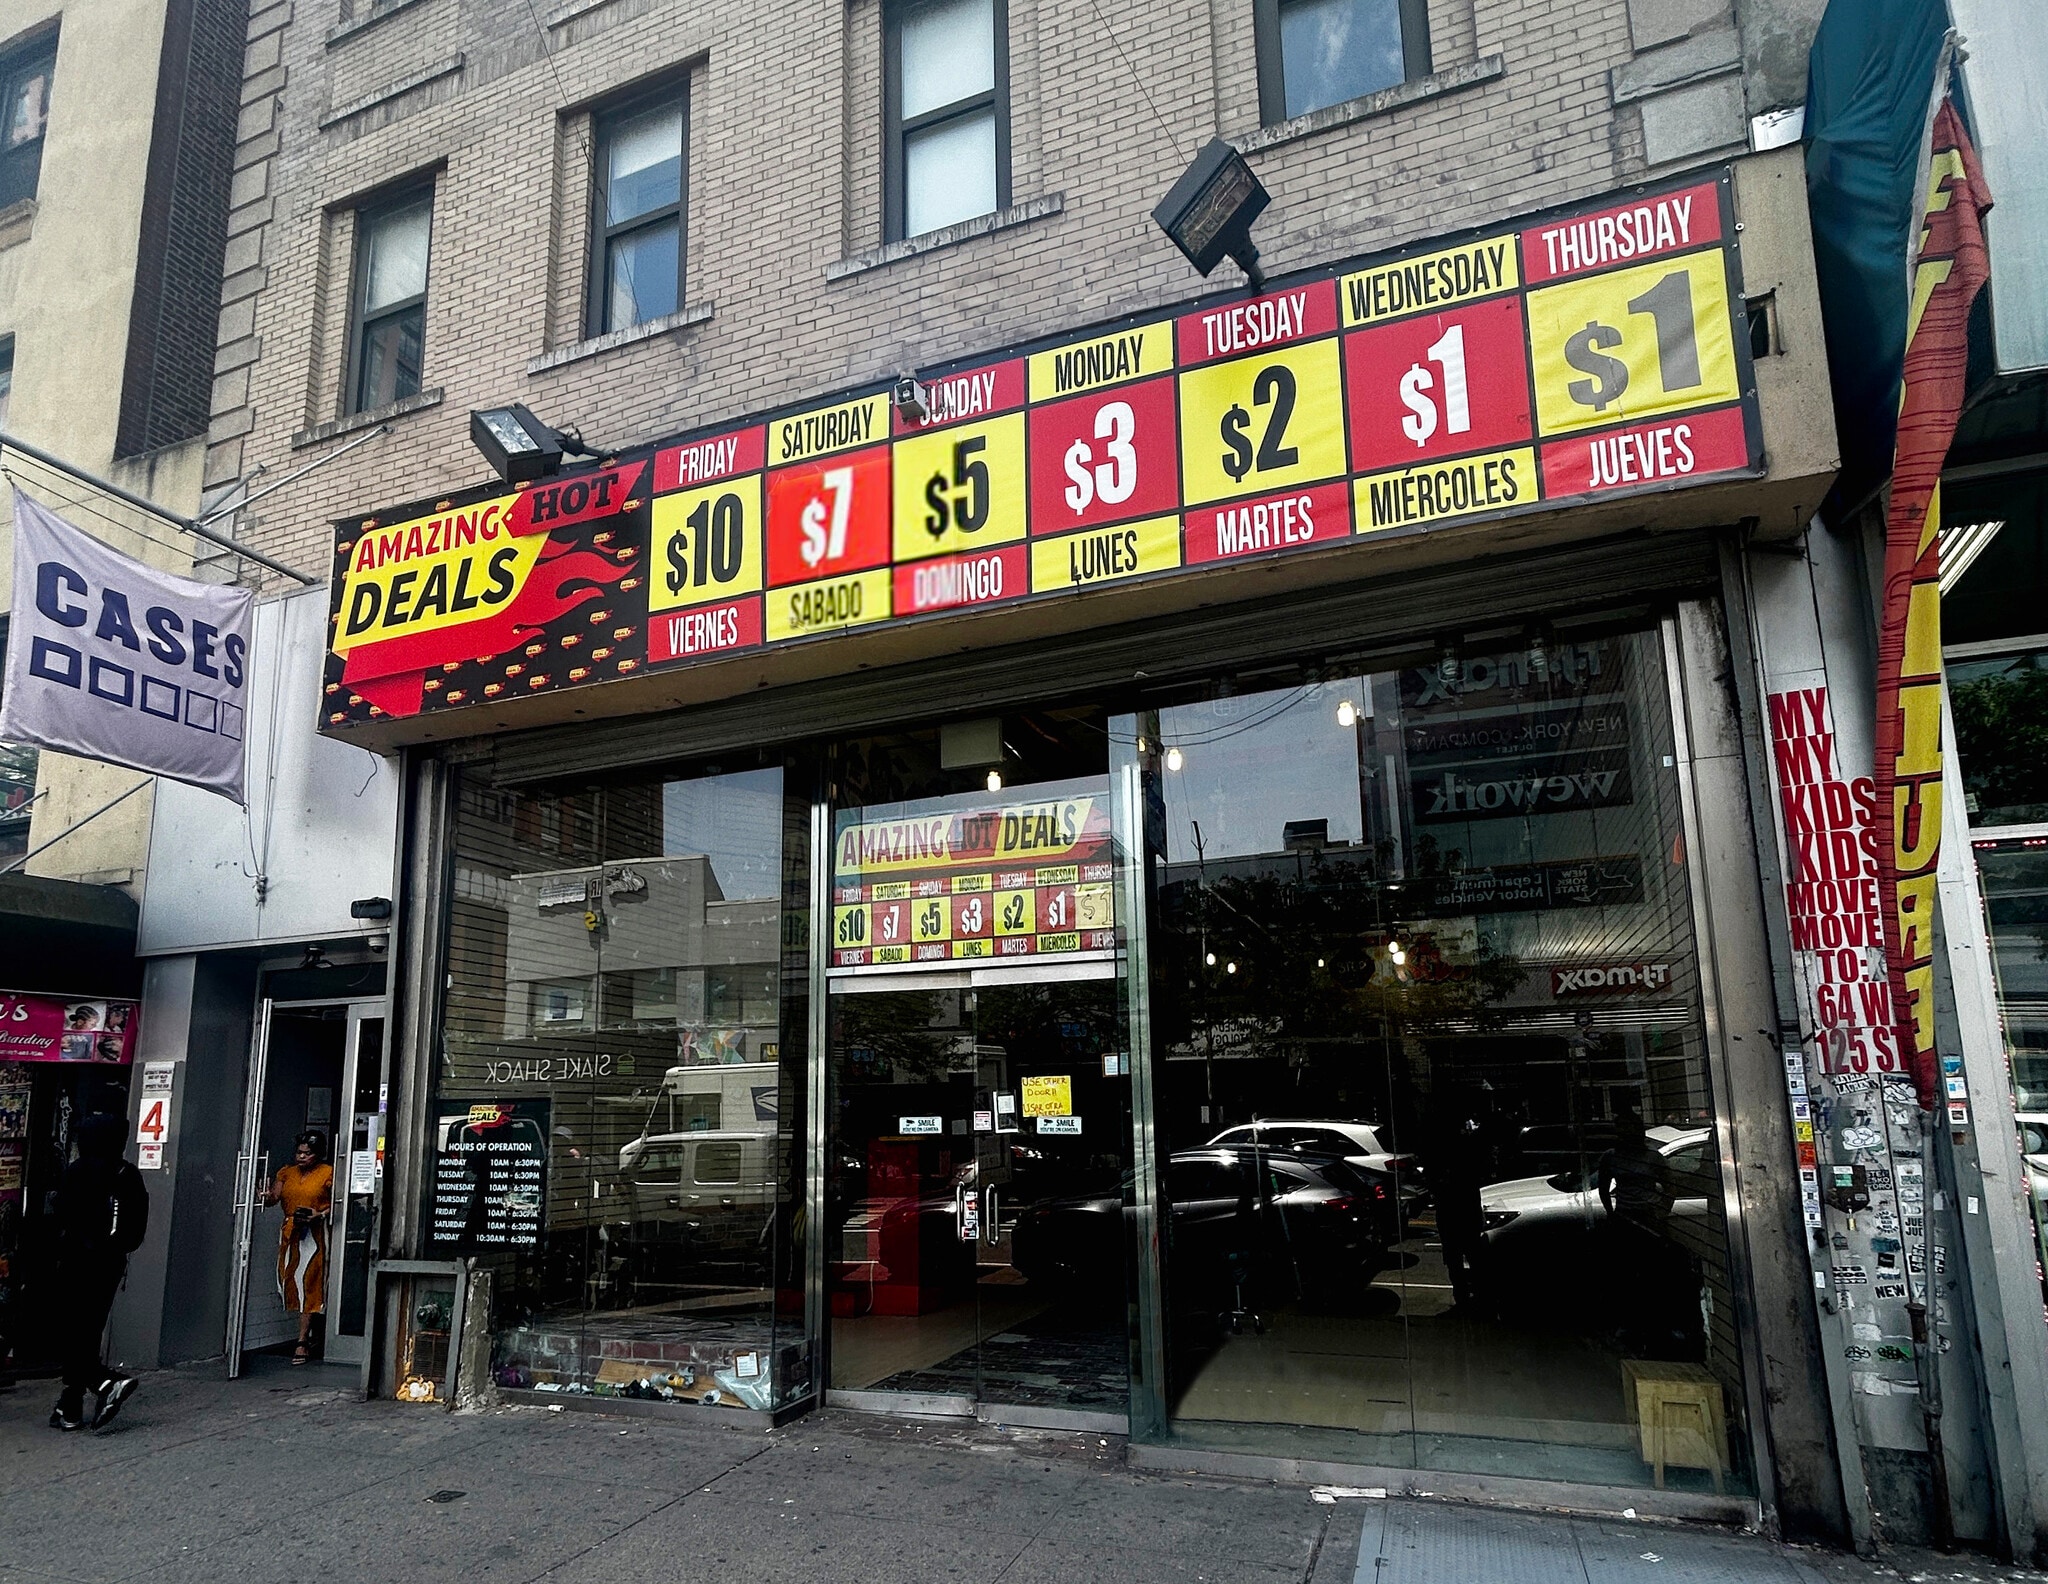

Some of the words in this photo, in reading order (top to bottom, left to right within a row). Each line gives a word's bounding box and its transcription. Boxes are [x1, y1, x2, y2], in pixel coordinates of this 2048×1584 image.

[1542, 196, 1692, 274] THURSDAY
[1349, 244, 1506, 320] WEDNESDAY
[1202, 292, 1306, 356] TUESDAY
[1564, 271, 1702, 412] $1
[1055, 335, 1143, 393] MONDAY
[1400, 324, 1471, 448] $1
[781, 403, 874, 459] SATURDAY
[1220, 365, 1299, 483] $2
[678, 437, 738, 484] FRIDAY
[1064, 402, 1138, 516] $3
[1590, 425, 1695, 489] JUEVES
[530, 472, 618, 524] HOT
[925, 435, 989, 541] $5
[1370, 459, 1518, 527] MIÉRCOLES
[356, 505, 500, 573] AMAZING
[800, 467, 855, 567] $7
[1216, 496, 1314, 555] MARTES
[666, 493, 743, 596] $10
[1070, 530, 1138, 582] LUNES
[346, 548, 519, 637] DEALS
[791, 581, 862, 625] SABADO
[914, 556, 1003, 608] DOMINGO
[36, 562, 245, 689] CASES
[668, 607, 739, 656] VIERNES
[1769, 687, 1826, 739] MY
[1775, 733, 1833, 787] MY
[1782, 776, 1876, 833] KIDS
[842, 821, 943, 867] AMAZING
[1004, 805, 1076, 852] DEALS
[1796, 828, 1878, 882] KIDS
[876, 883, 906, 899] SATURDAY
[1000, 872, 1027, 888] TUESDAY
[1037, 867, 1076, 885] WEDNESDAY
[1787, 878, 1878, 917] MOVE
[840, 907, 865, 943] $10
[883, 905, 899, 940] $7
[921, 902, 941, 937] $5
[961, 898, 982, 934] $3
[1003, 894, 1024, 930] $2
[1048, 890, 1066, 928] $1
[1791, 912, 1883, 951] MOVE
[918, 944, 945, 959] DOMINGO
[963, 941, 982, 957] LUNES
[1002, 938, 1027, 954] MARTES
[1816, 949, 1870, 984] TO:
[1817, 982, 1856, 1030] 64
[1862, 982, 1889, 1026] W
[1816, 1027, 1868, 1075] 125
[1022, 1078, 1042, 1087] USE
[140, 1100, 164, 1142] 4
[918, 1119, 935, 1127] SMILE
[1056, 1119, 1074, 1127] SMILE
[449, 1143, 475, 1151] HOURS
[476, 1143, 487, 1152] OF
[488, 1143, 532, 1152] OPERATION
[490, 1159, 509, 1167] 10AM
[514, 1159, 541, 1167] 6:30PM
[436, 1195, 468, 1203] THURSDAY
[437, 1183, 475, 1191] WEDNESDAY
[513, 1184, 539, 1192] 6:30PM
[490, 1171, 508, 1179] 10AM
[434, 1220, 467, 1228] SATURDAY
[487, 1221, 506, 1229] 10AM
[511, 1222, 537, 1231] 6:30PM
[434, 1233, 460, 1241] SUNDAY
[476, 1234, 506, 1242] 10:30AM
[510, 1236, 537, 1244] 6:30PM
[487, 1209, 507, 1217] 10AM
[1875, 1284, 1906, 1298] NEW
